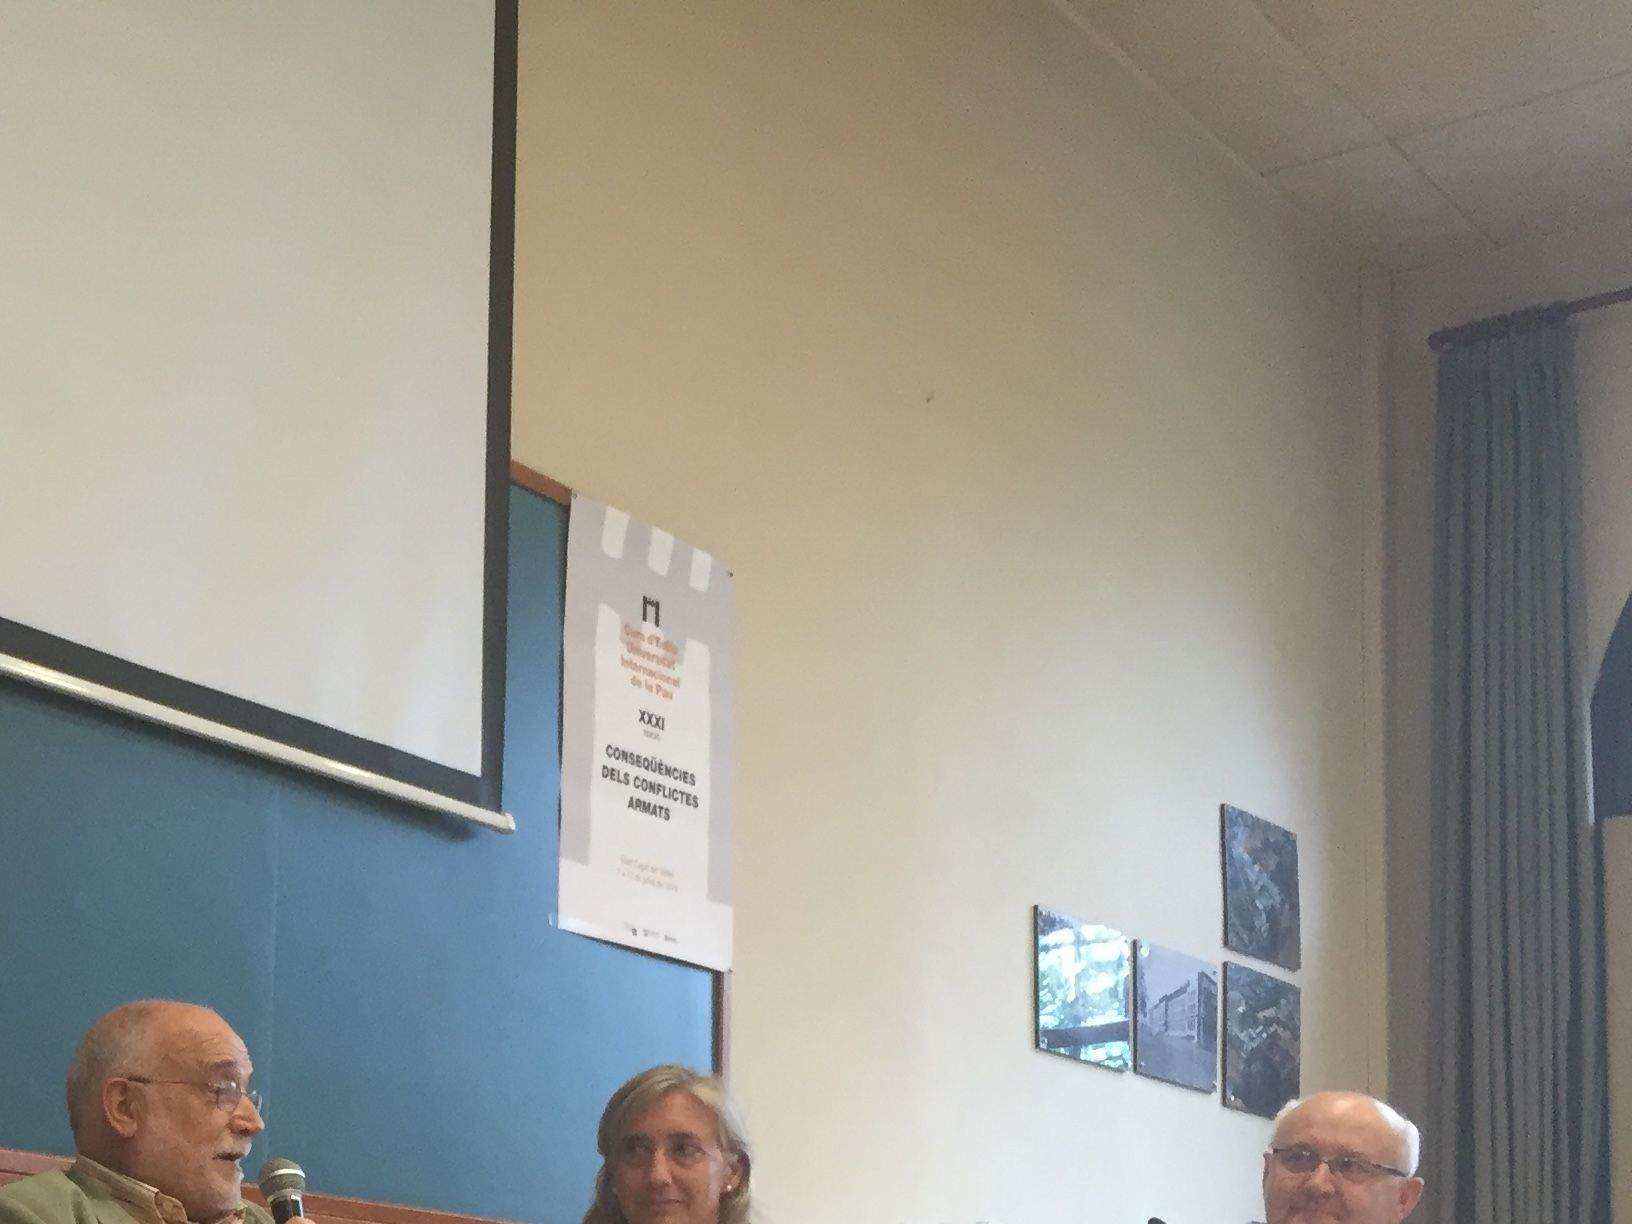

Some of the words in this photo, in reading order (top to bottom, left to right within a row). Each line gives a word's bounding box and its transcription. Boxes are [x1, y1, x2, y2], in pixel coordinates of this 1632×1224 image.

[638, 708, 666, 731] XXXI
[601, 764, 630, 786] DELS
[633, 775, 699, 808] CONFLICTES
[627, 796, 671, 821] ARMATS
